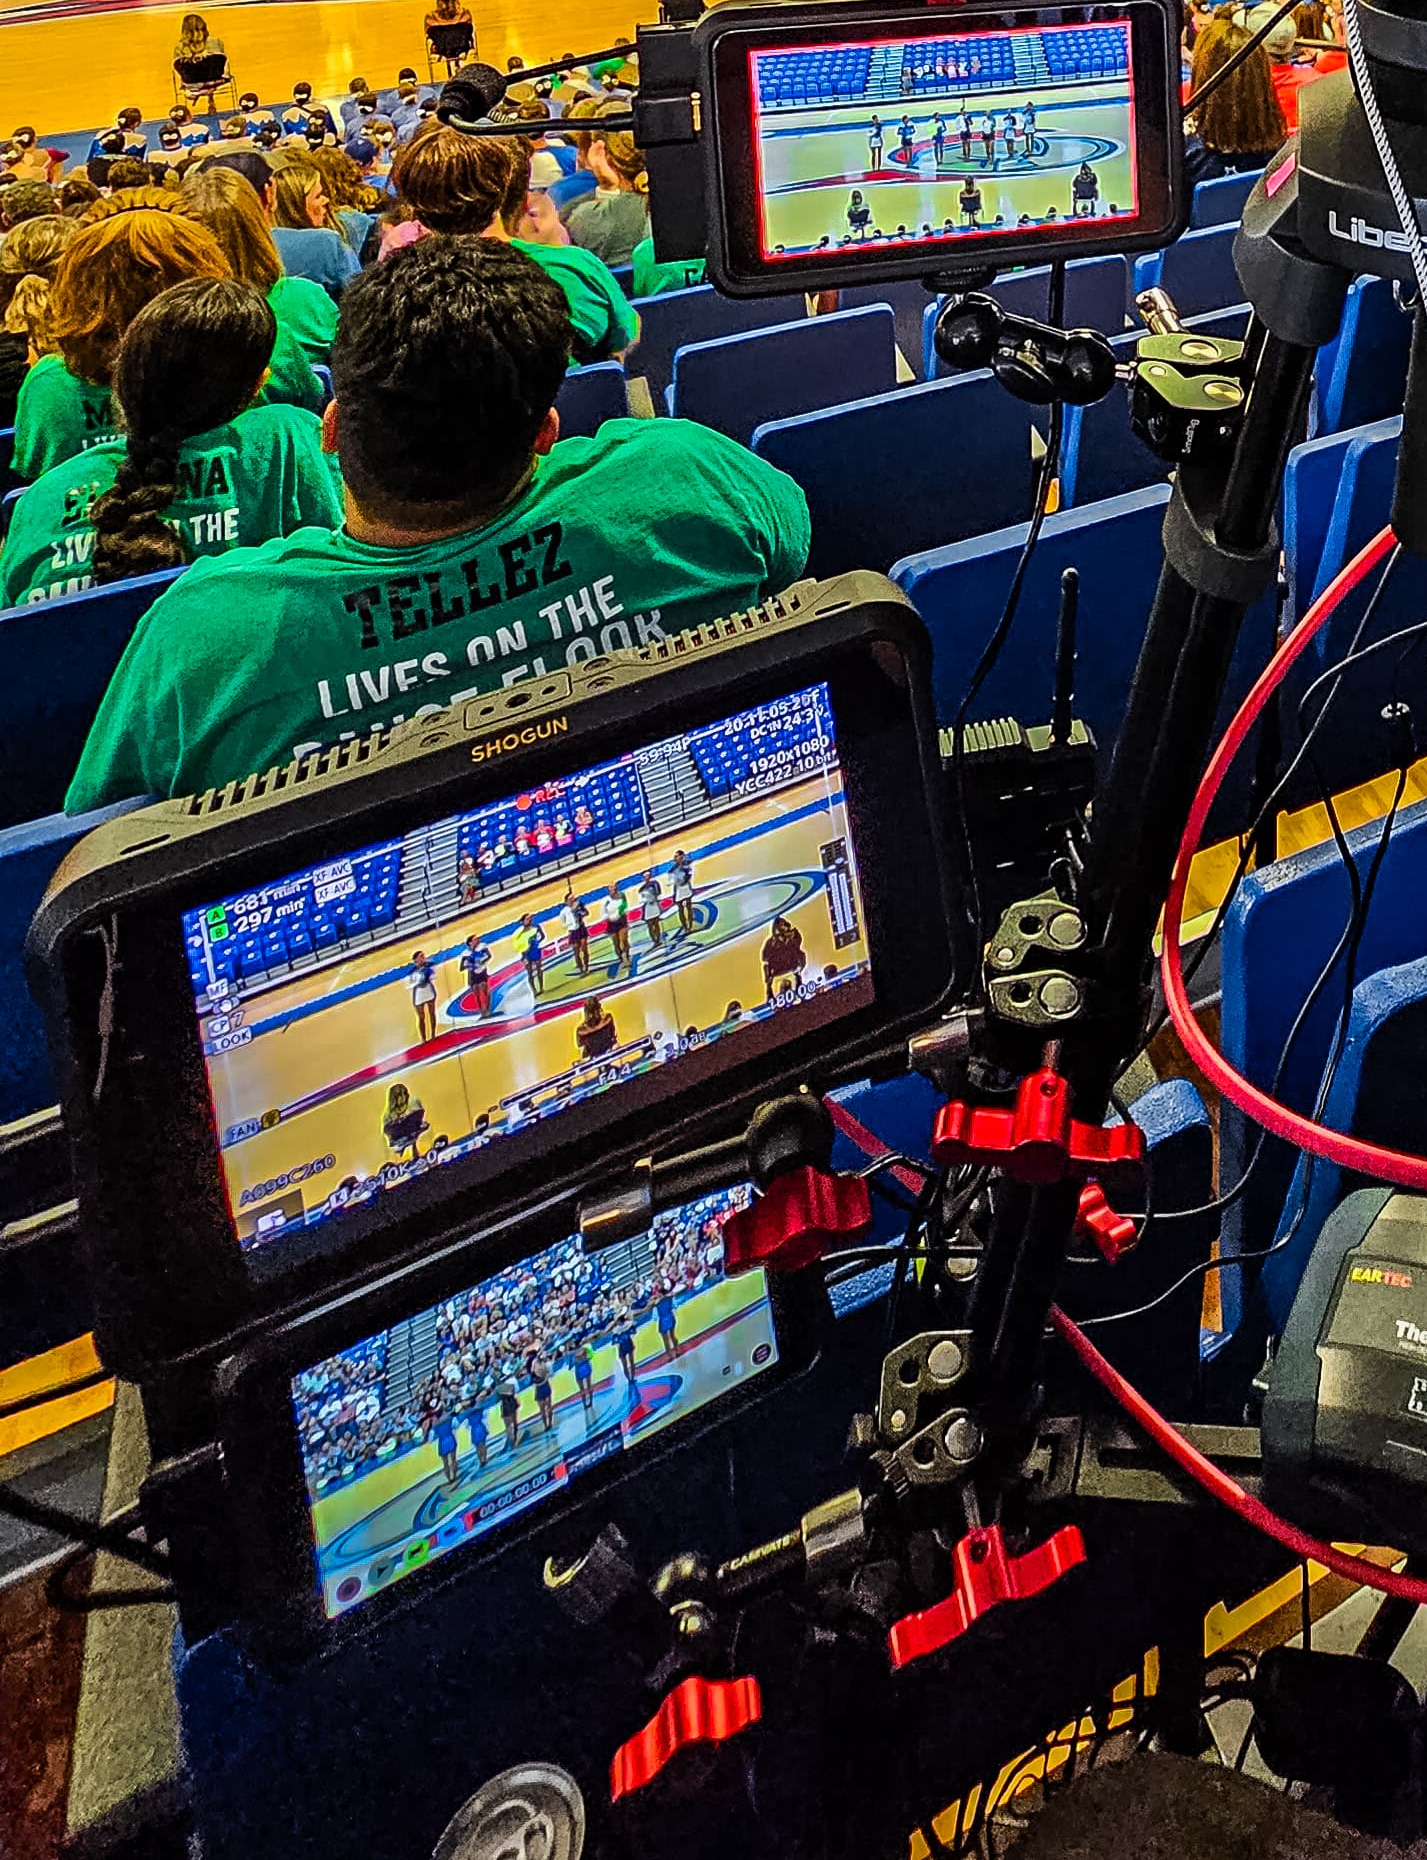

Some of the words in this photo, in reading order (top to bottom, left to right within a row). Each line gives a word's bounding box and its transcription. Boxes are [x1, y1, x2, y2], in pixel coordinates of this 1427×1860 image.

[188, 507, 240, 545] THE
[50, 531, 96, 570] LIV
[343, 522, 574, 650] TELLEZ
[316, 650, 452, 719] LIVES
[466, 620, 529, 668] ON
[538, 574, 625, 640] THE
[470, 716, 569, 764] SHOGUN
[748, 732, 831, 775] 1920x1080
[232, 905, 275, 934] 297
[1351, 1266, 1412, 1288] EARTEC
